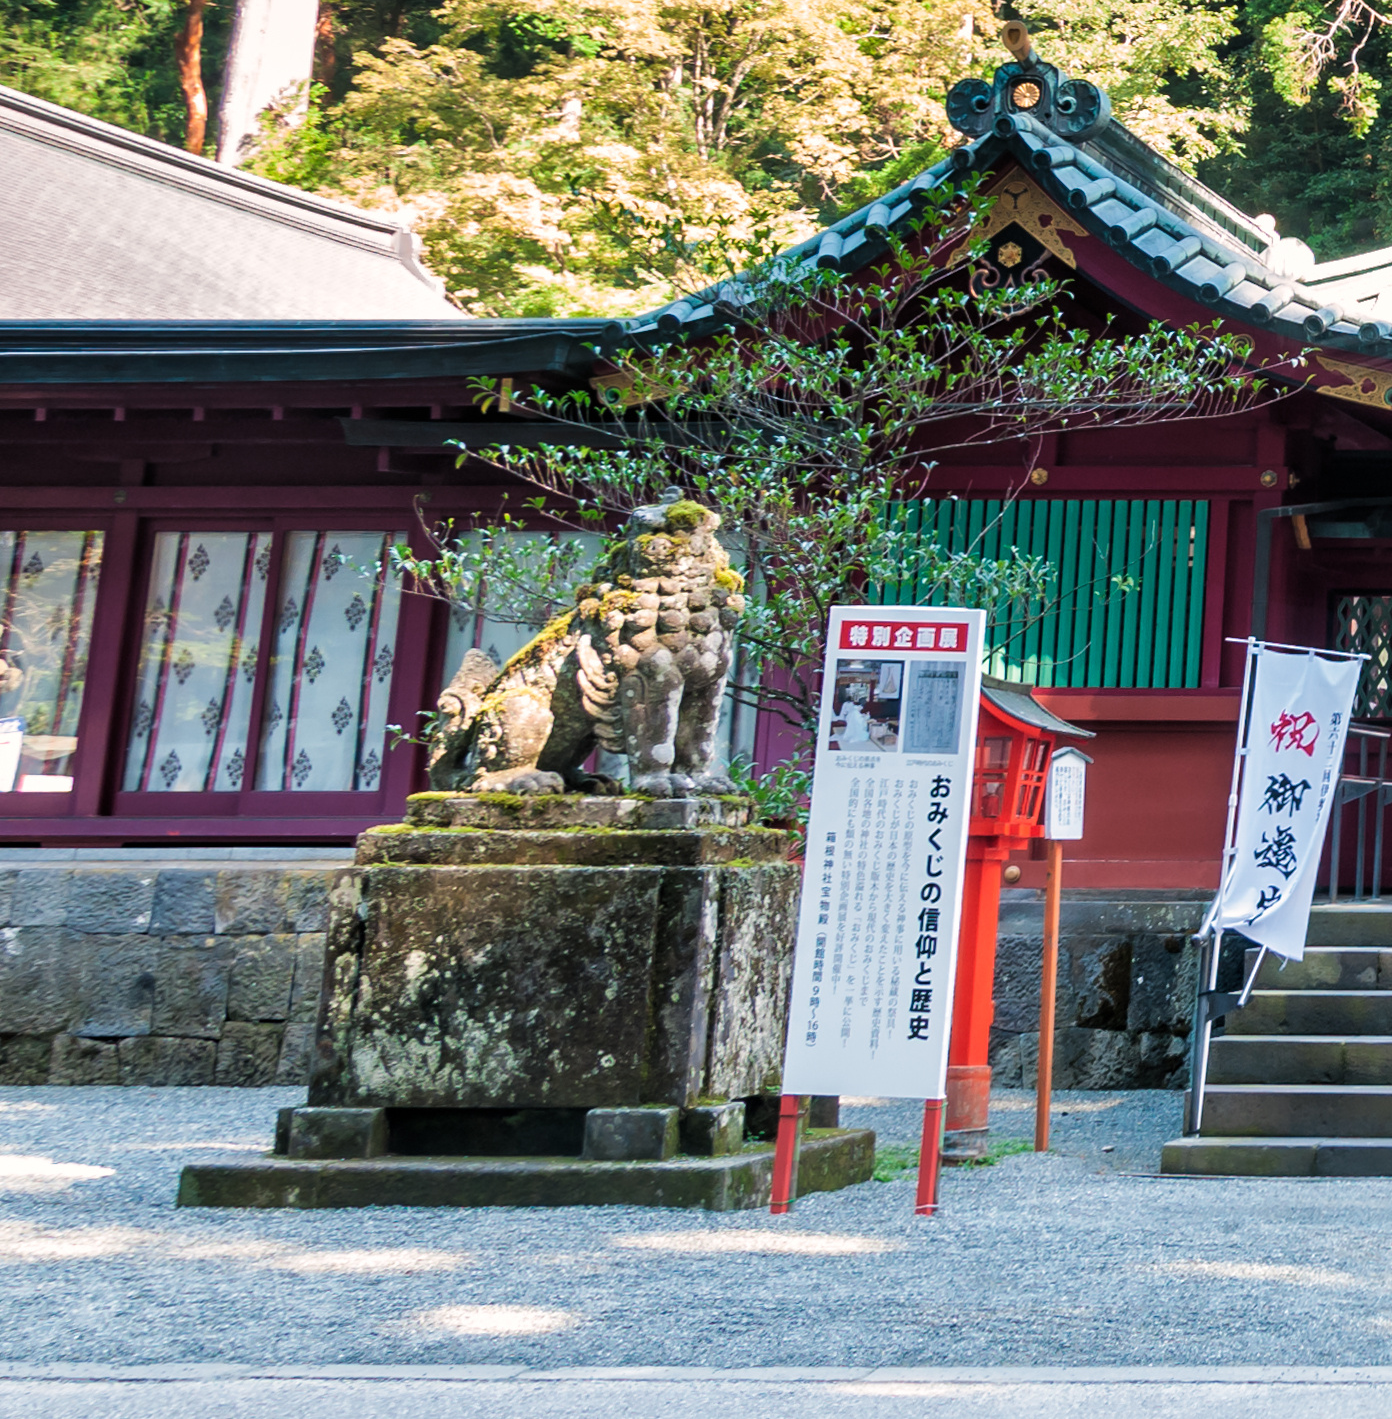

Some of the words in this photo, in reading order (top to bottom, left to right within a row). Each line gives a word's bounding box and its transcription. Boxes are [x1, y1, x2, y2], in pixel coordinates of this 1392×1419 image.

[849, 624, 958, 649] 特別企画展
[907, 774, 952, 1041] おみくじの信仰と歴史
